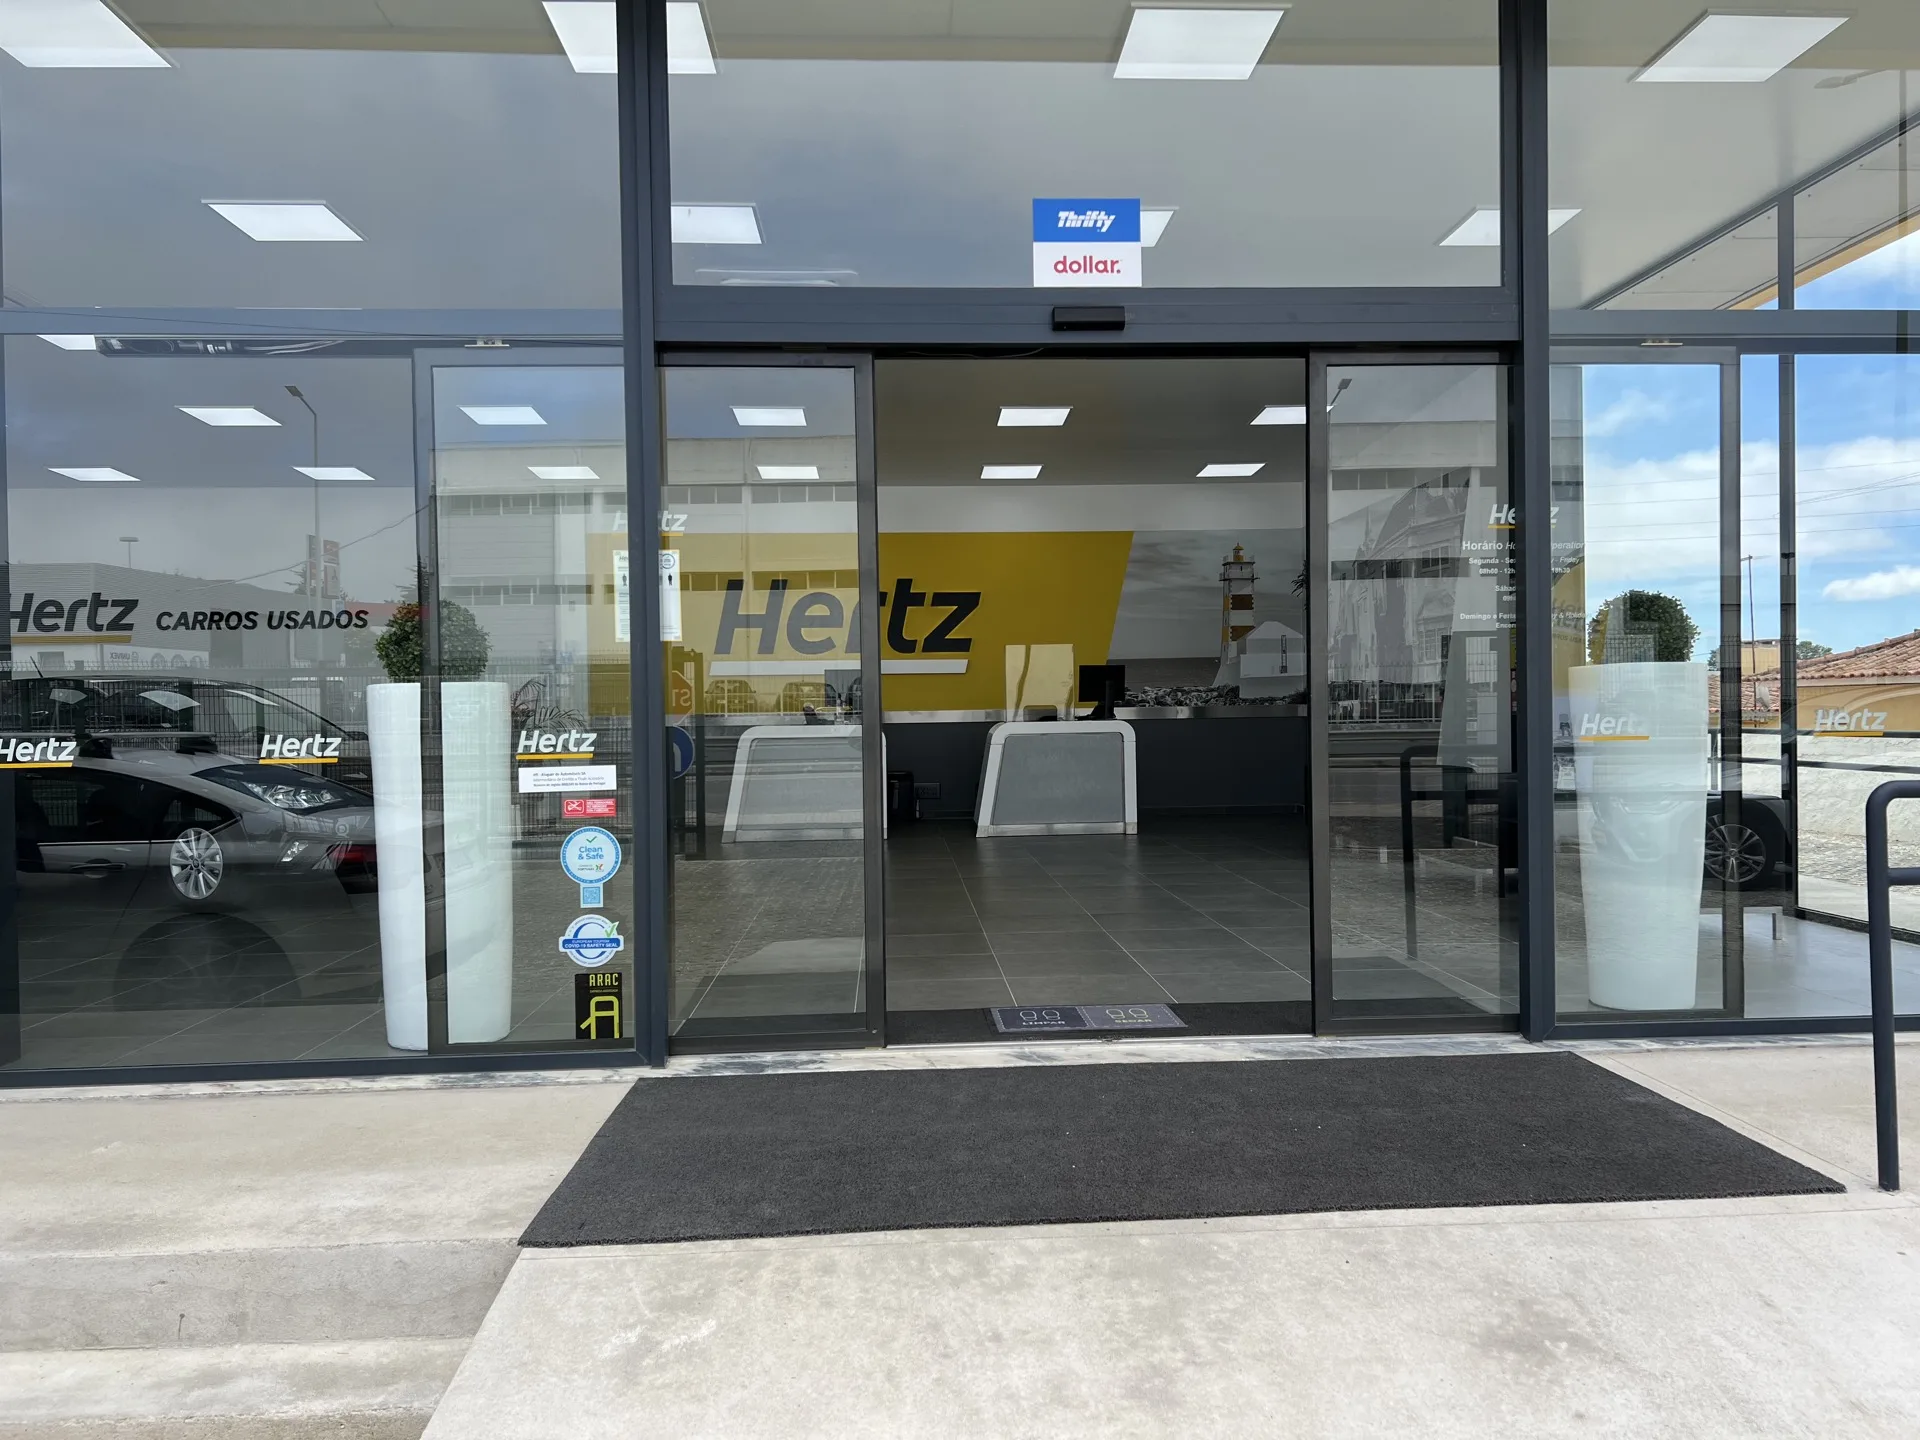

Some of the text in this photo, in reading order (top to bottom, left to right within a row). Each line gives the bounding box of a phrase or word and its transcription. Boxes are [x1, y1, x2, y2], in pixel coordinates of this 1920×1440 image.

[1057, 210, 1116, 232] Thrifty
[1053, 255, 1121, 274] dollar.
[613, 509, 688, 531] Htz
[1488, 503, 1560, 524] Hez
[1462, 540, 1503, 551] Horário
[7, 592, 369, 632] Hertz CARROS USADOS
[1814, 708, 1888, 731] Hertz
[0, 738, 77, 762] Hertz
[261, 734, 342, 757] Hertz
[518, 730, 597, 753] Hertz
[589, 973, 619, 987] ARAC
